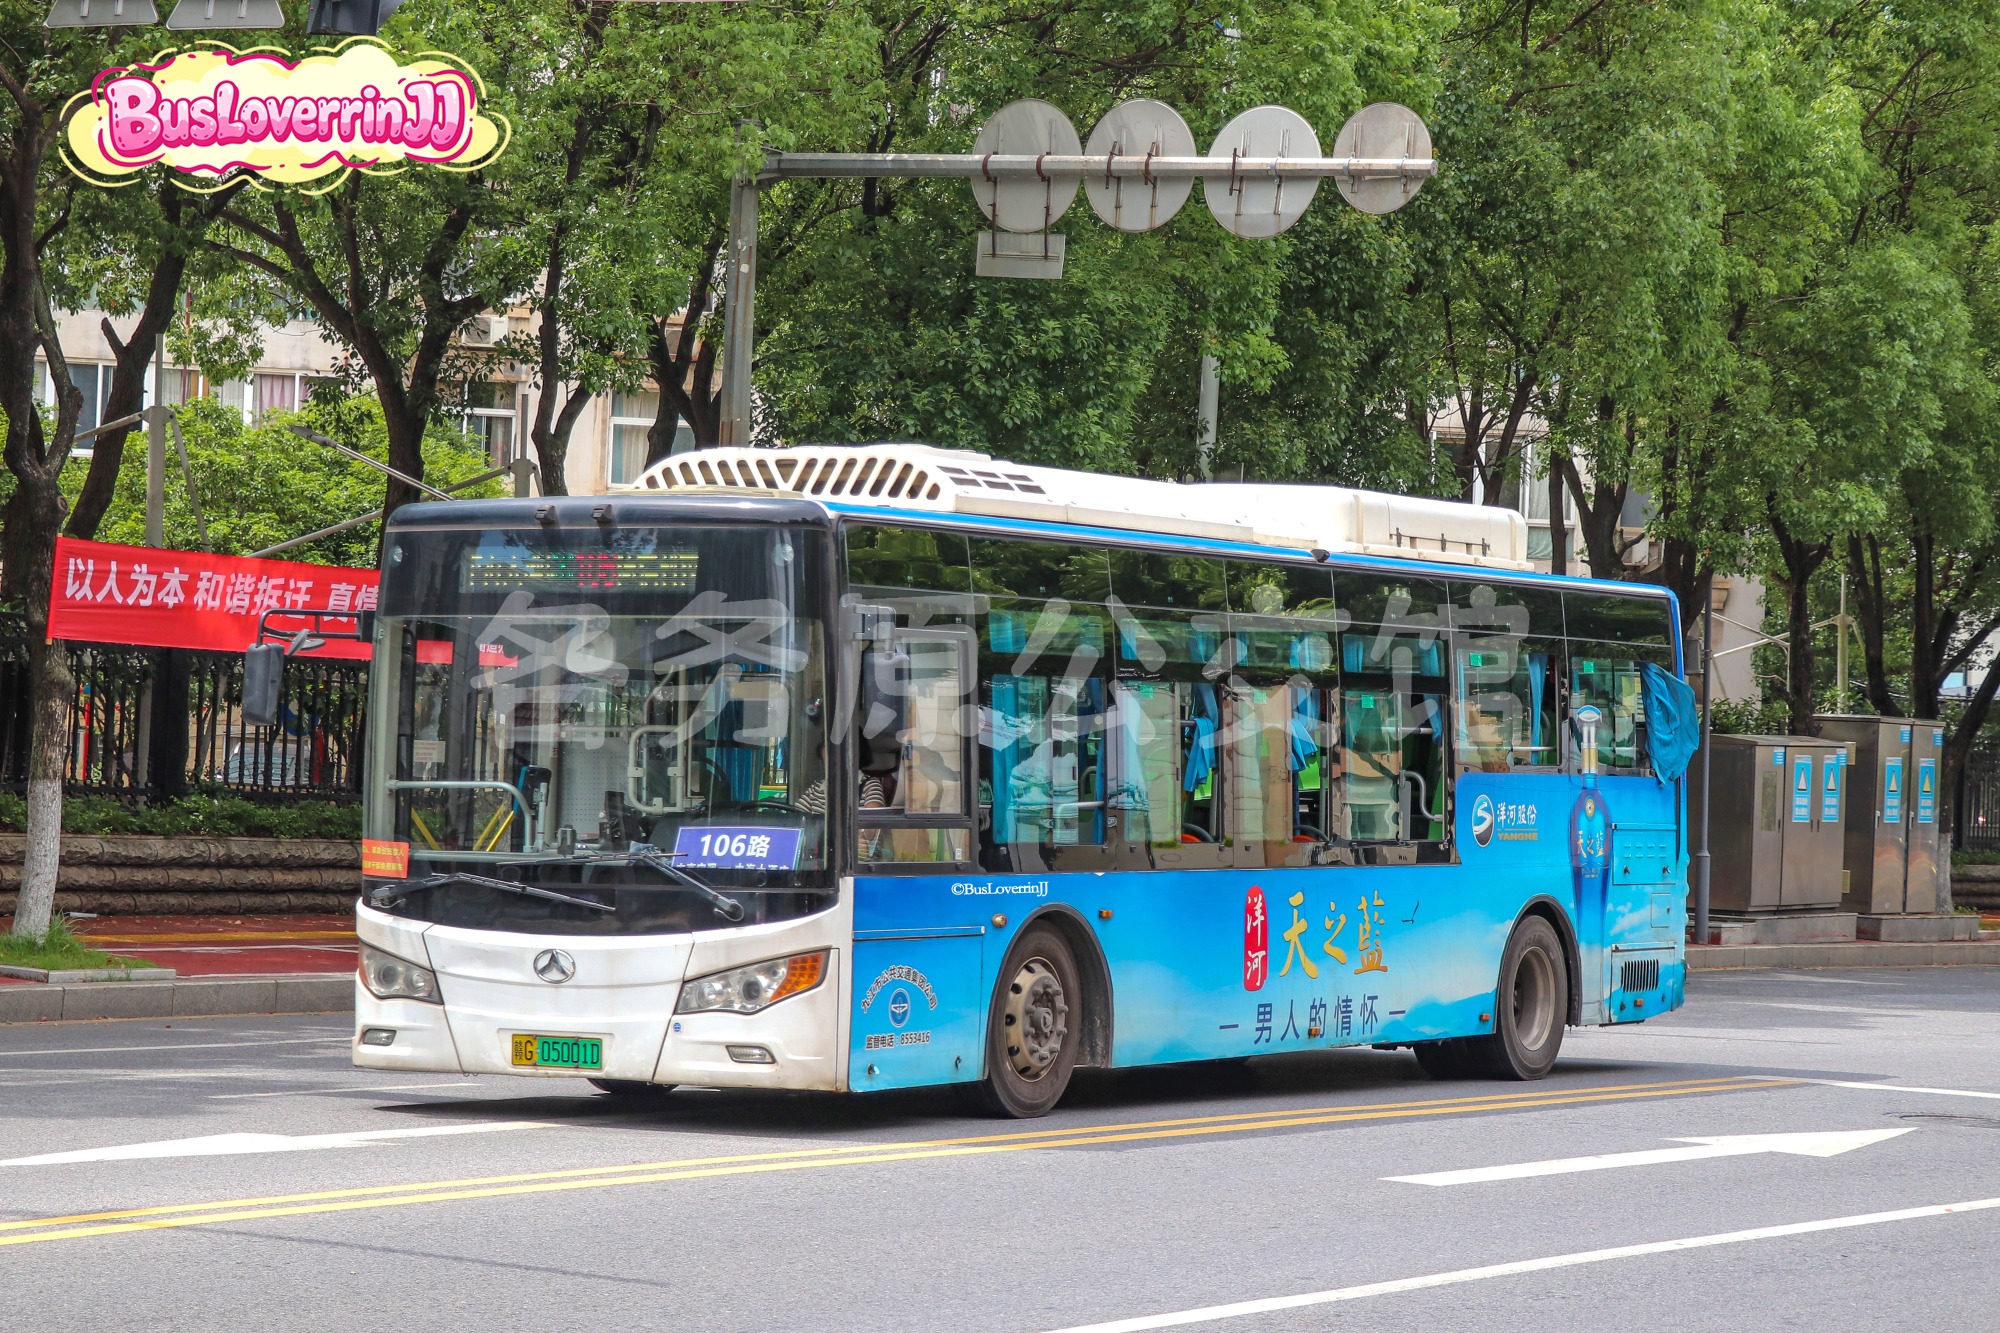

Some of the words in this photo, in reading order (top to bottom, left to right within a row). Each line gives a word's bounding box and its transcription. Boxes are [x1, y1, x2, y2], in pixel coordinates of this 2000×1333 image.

[65, 557, 189, 609] 以人为本
[193, 571, 313, 620] 和谐拆迁
[1497, 802, 1537, 829] 洋河股份
[700, 834, 771, 858] 106路
[1497, 833, 1539, 841] YANGHE
[1246, 894, 1267, 986] 洋河
[861, 965, 938, 1013] 九江市公共交通集团公司
